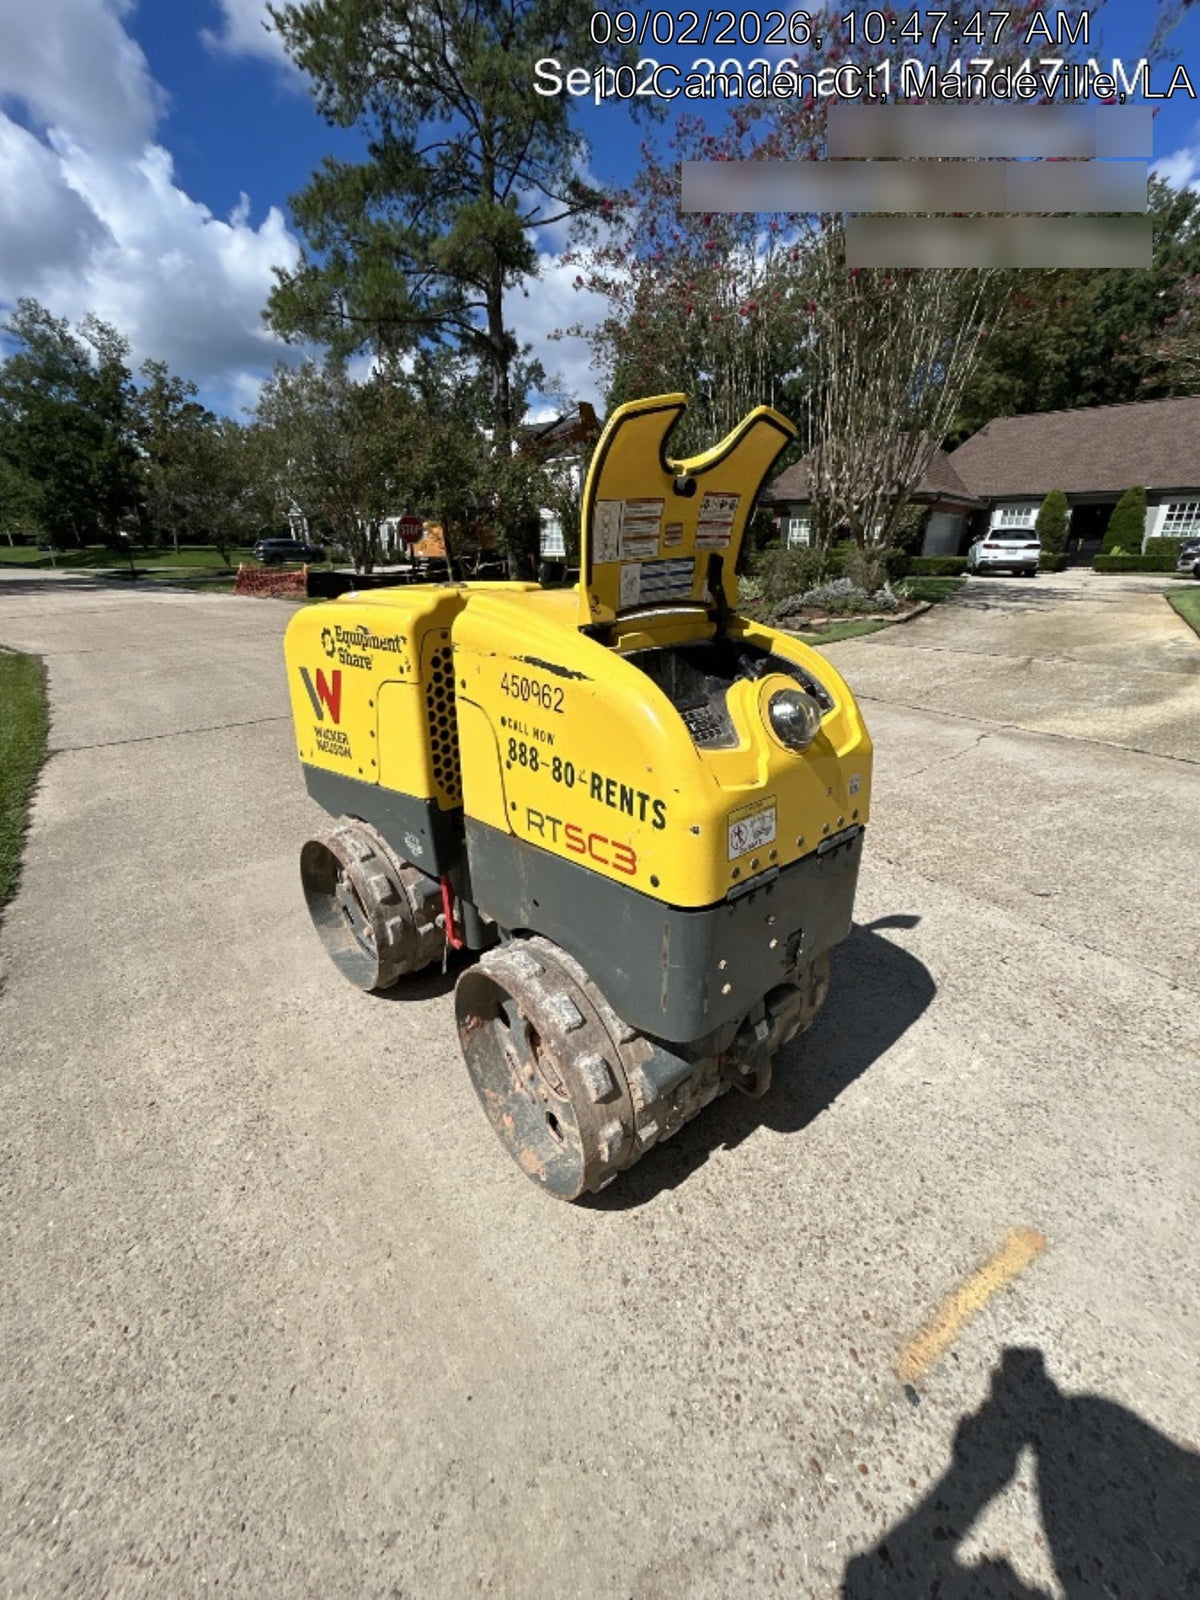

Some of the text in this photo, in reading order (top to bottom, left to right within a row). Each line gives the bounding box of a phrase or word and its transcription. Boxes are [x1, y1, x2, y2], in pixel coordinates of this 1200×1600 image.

[400, 523, 421, 536] STOP
[334, 625, 403, 653] Equipment
[337, 647, 373, 670] Share
[500, 672, 565, 714] 450962
